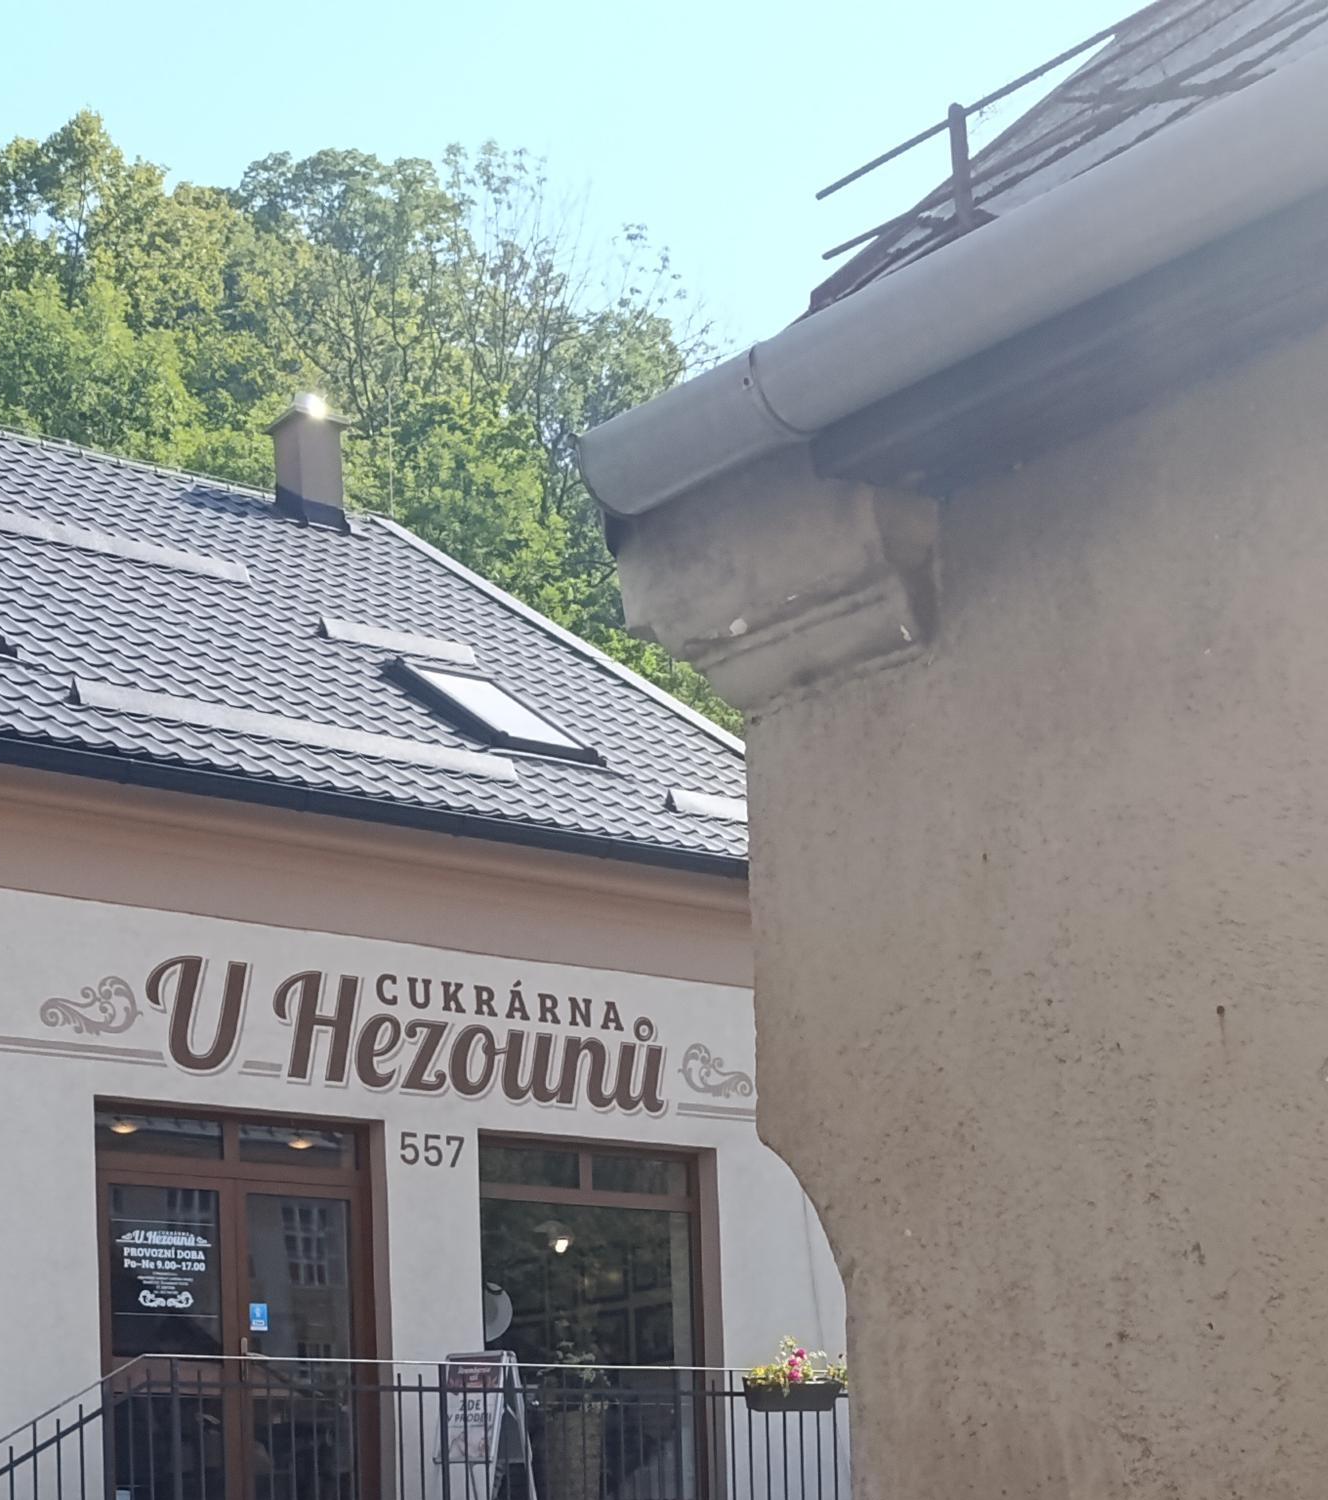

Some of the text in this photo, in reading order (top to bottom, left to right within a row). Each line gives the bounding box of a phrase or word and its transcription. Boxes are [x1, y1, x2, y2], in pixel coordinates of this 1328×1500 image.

[375, 973, 624, 1032] CUKRÁRNA
[144, 954, 670, 1113] U Hezounů
[399, 1131, 464, 1168] 557
[133, 1230, 195, 1246] U Hezounů
[123, 1247, 205, 1260] PROVOZNÍ DOBA
[459, 1400, 481, 1411] ZDE
